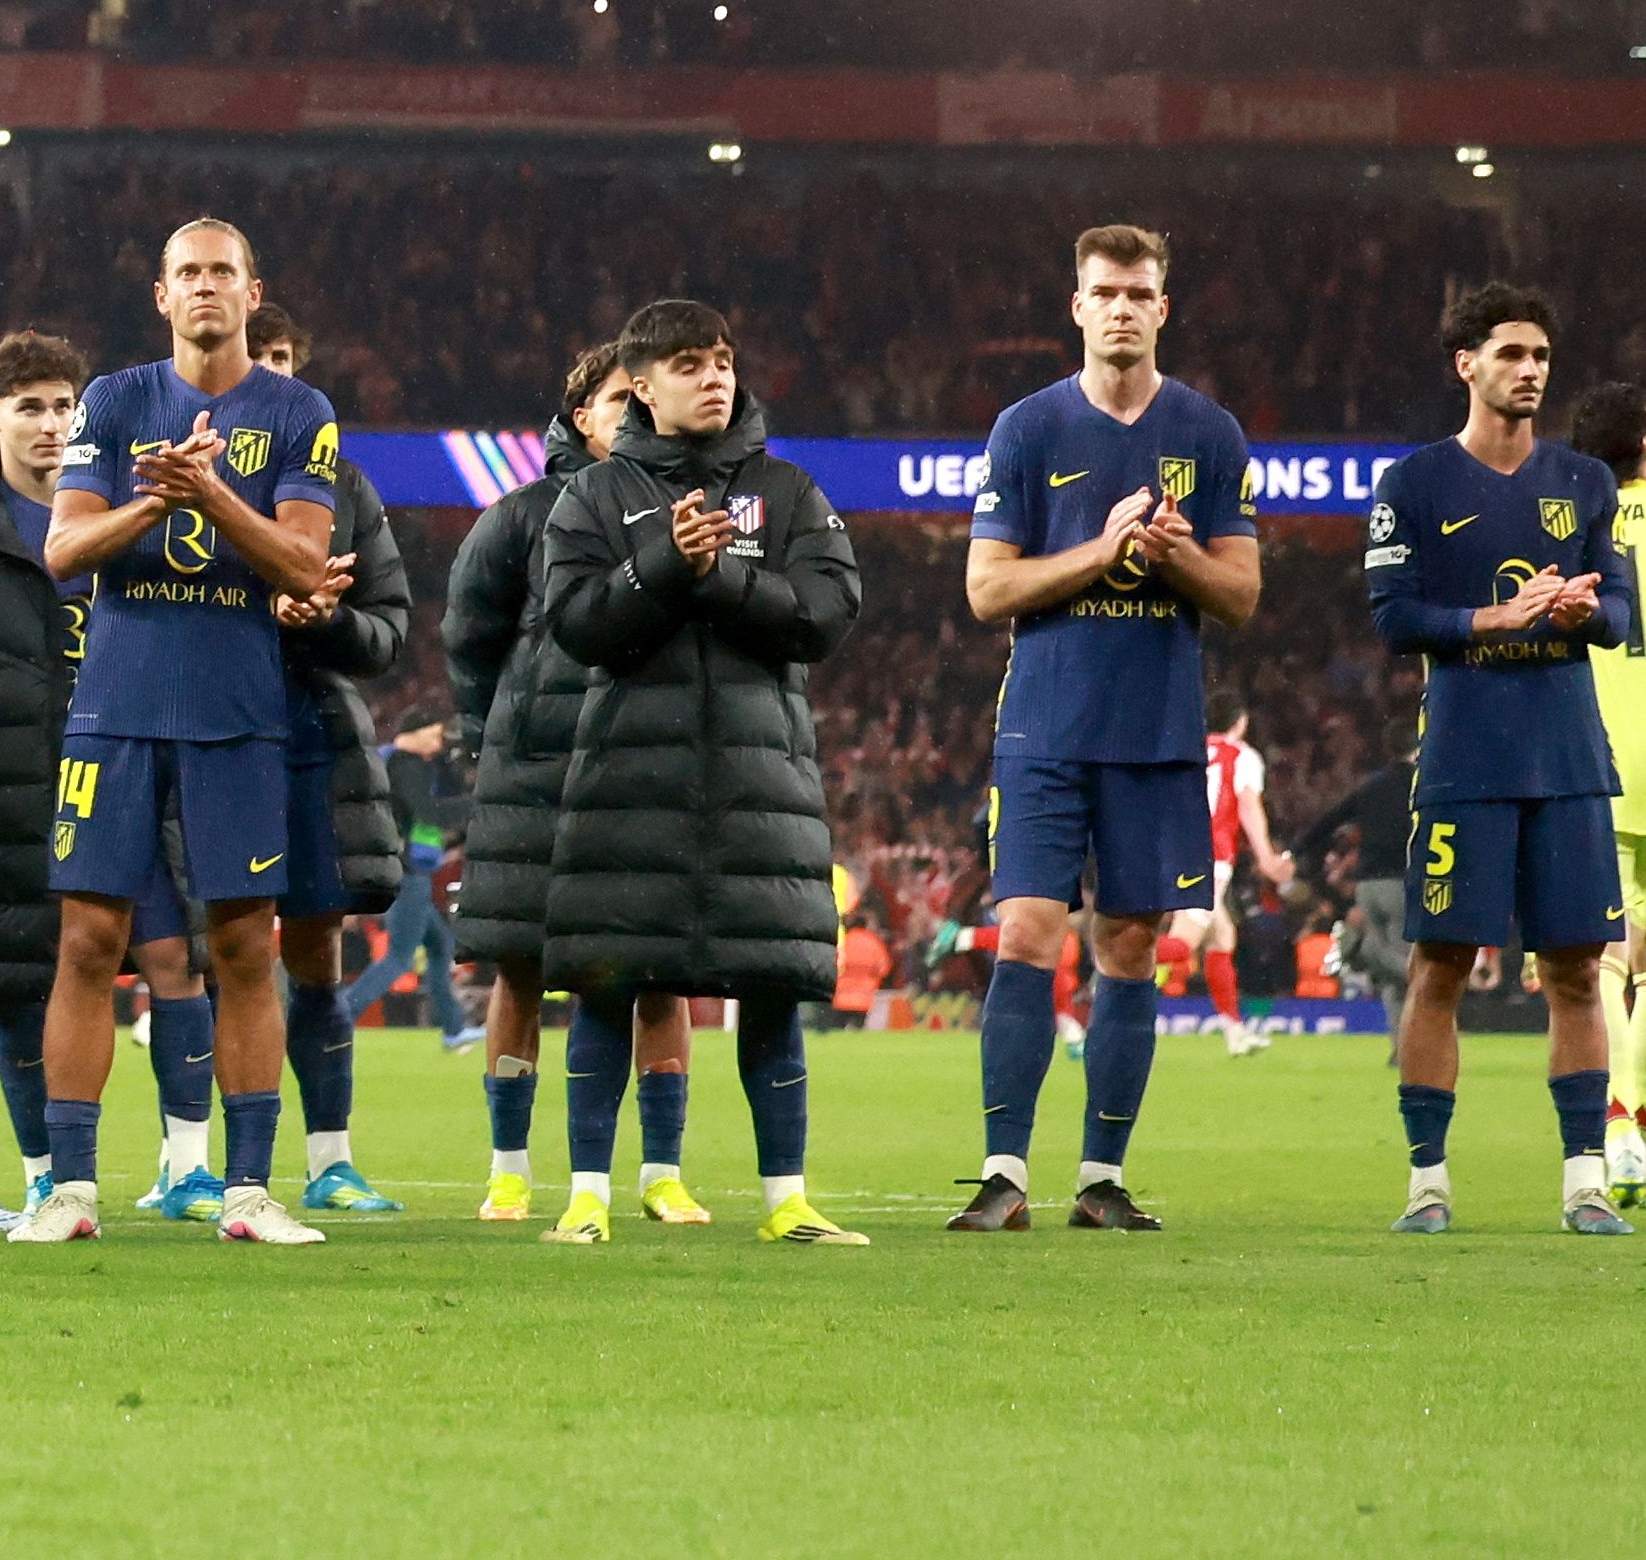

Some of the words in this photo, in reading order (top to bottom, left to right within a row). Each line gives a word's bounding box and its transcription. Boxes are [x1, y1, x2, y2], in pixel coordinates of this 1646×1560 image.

[899, 454, 985, 497] UEF
[734, 539, 759, 549] VISIT
[126, 581, 205, 603] RIYADH
[211, 587, 247, 607] AIR
[1070, 599, 1142, 619] RIYADH
[1147, 600, 1177, 619] AIR
[1466, 641, 1539, 665] RIYADH
[59, 756, 100, 819] 14
[1426, 822, 1457, 877] 5
